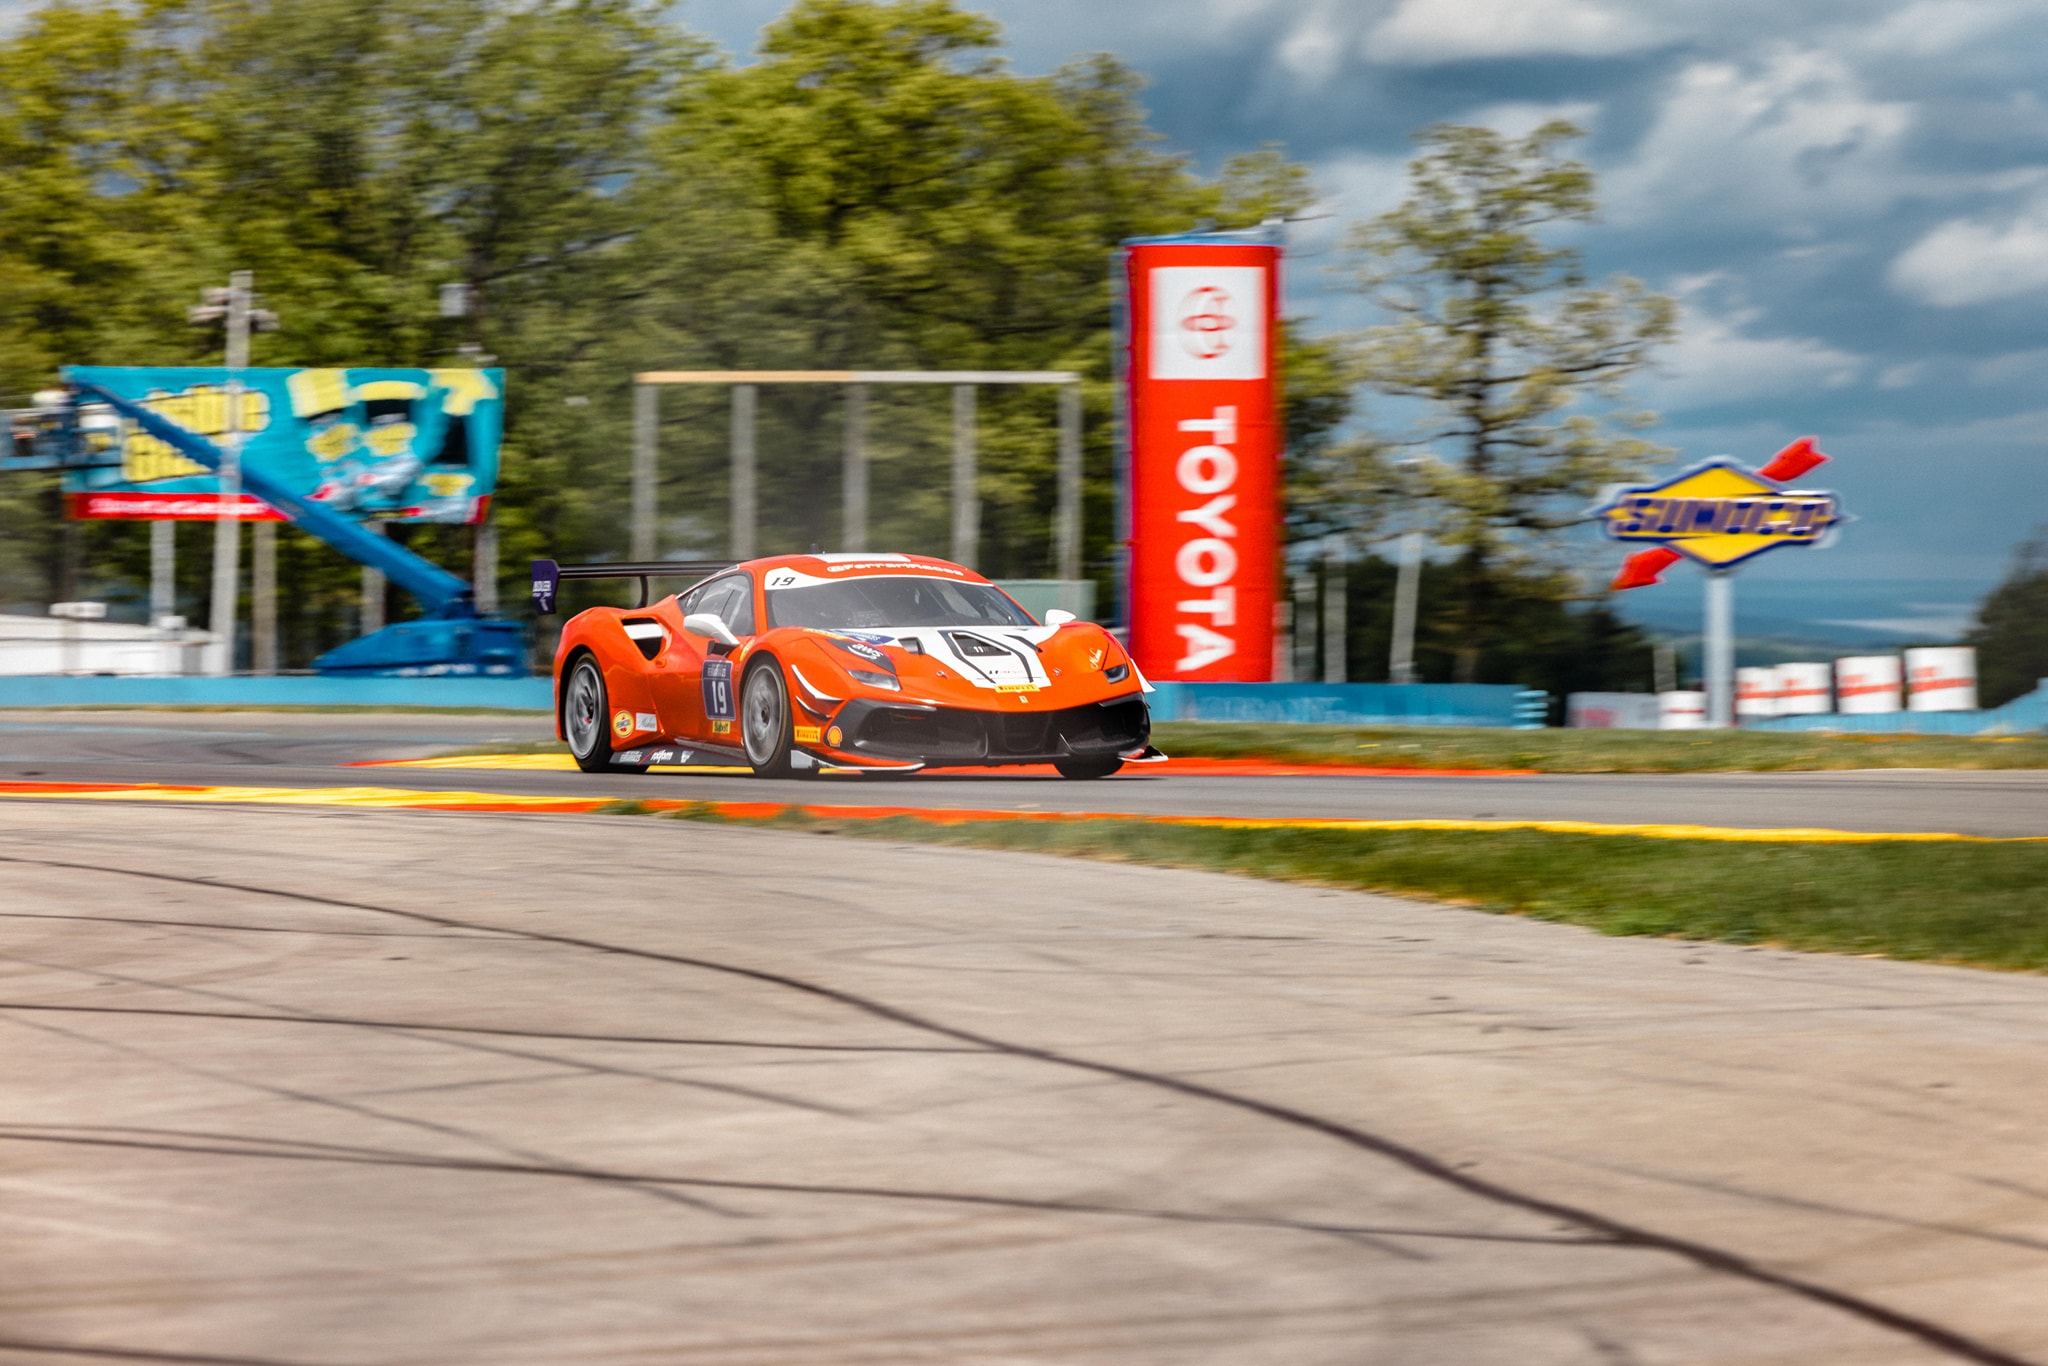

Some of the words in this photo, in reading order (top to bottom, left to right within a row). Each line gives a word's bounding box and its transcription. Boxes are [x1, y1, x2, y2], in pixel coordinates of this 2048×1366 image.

[1176, 405, 1238, 673] TOYOTA
[771, 577, 796, 586] 19
[712, 680, 727, 714] 19
